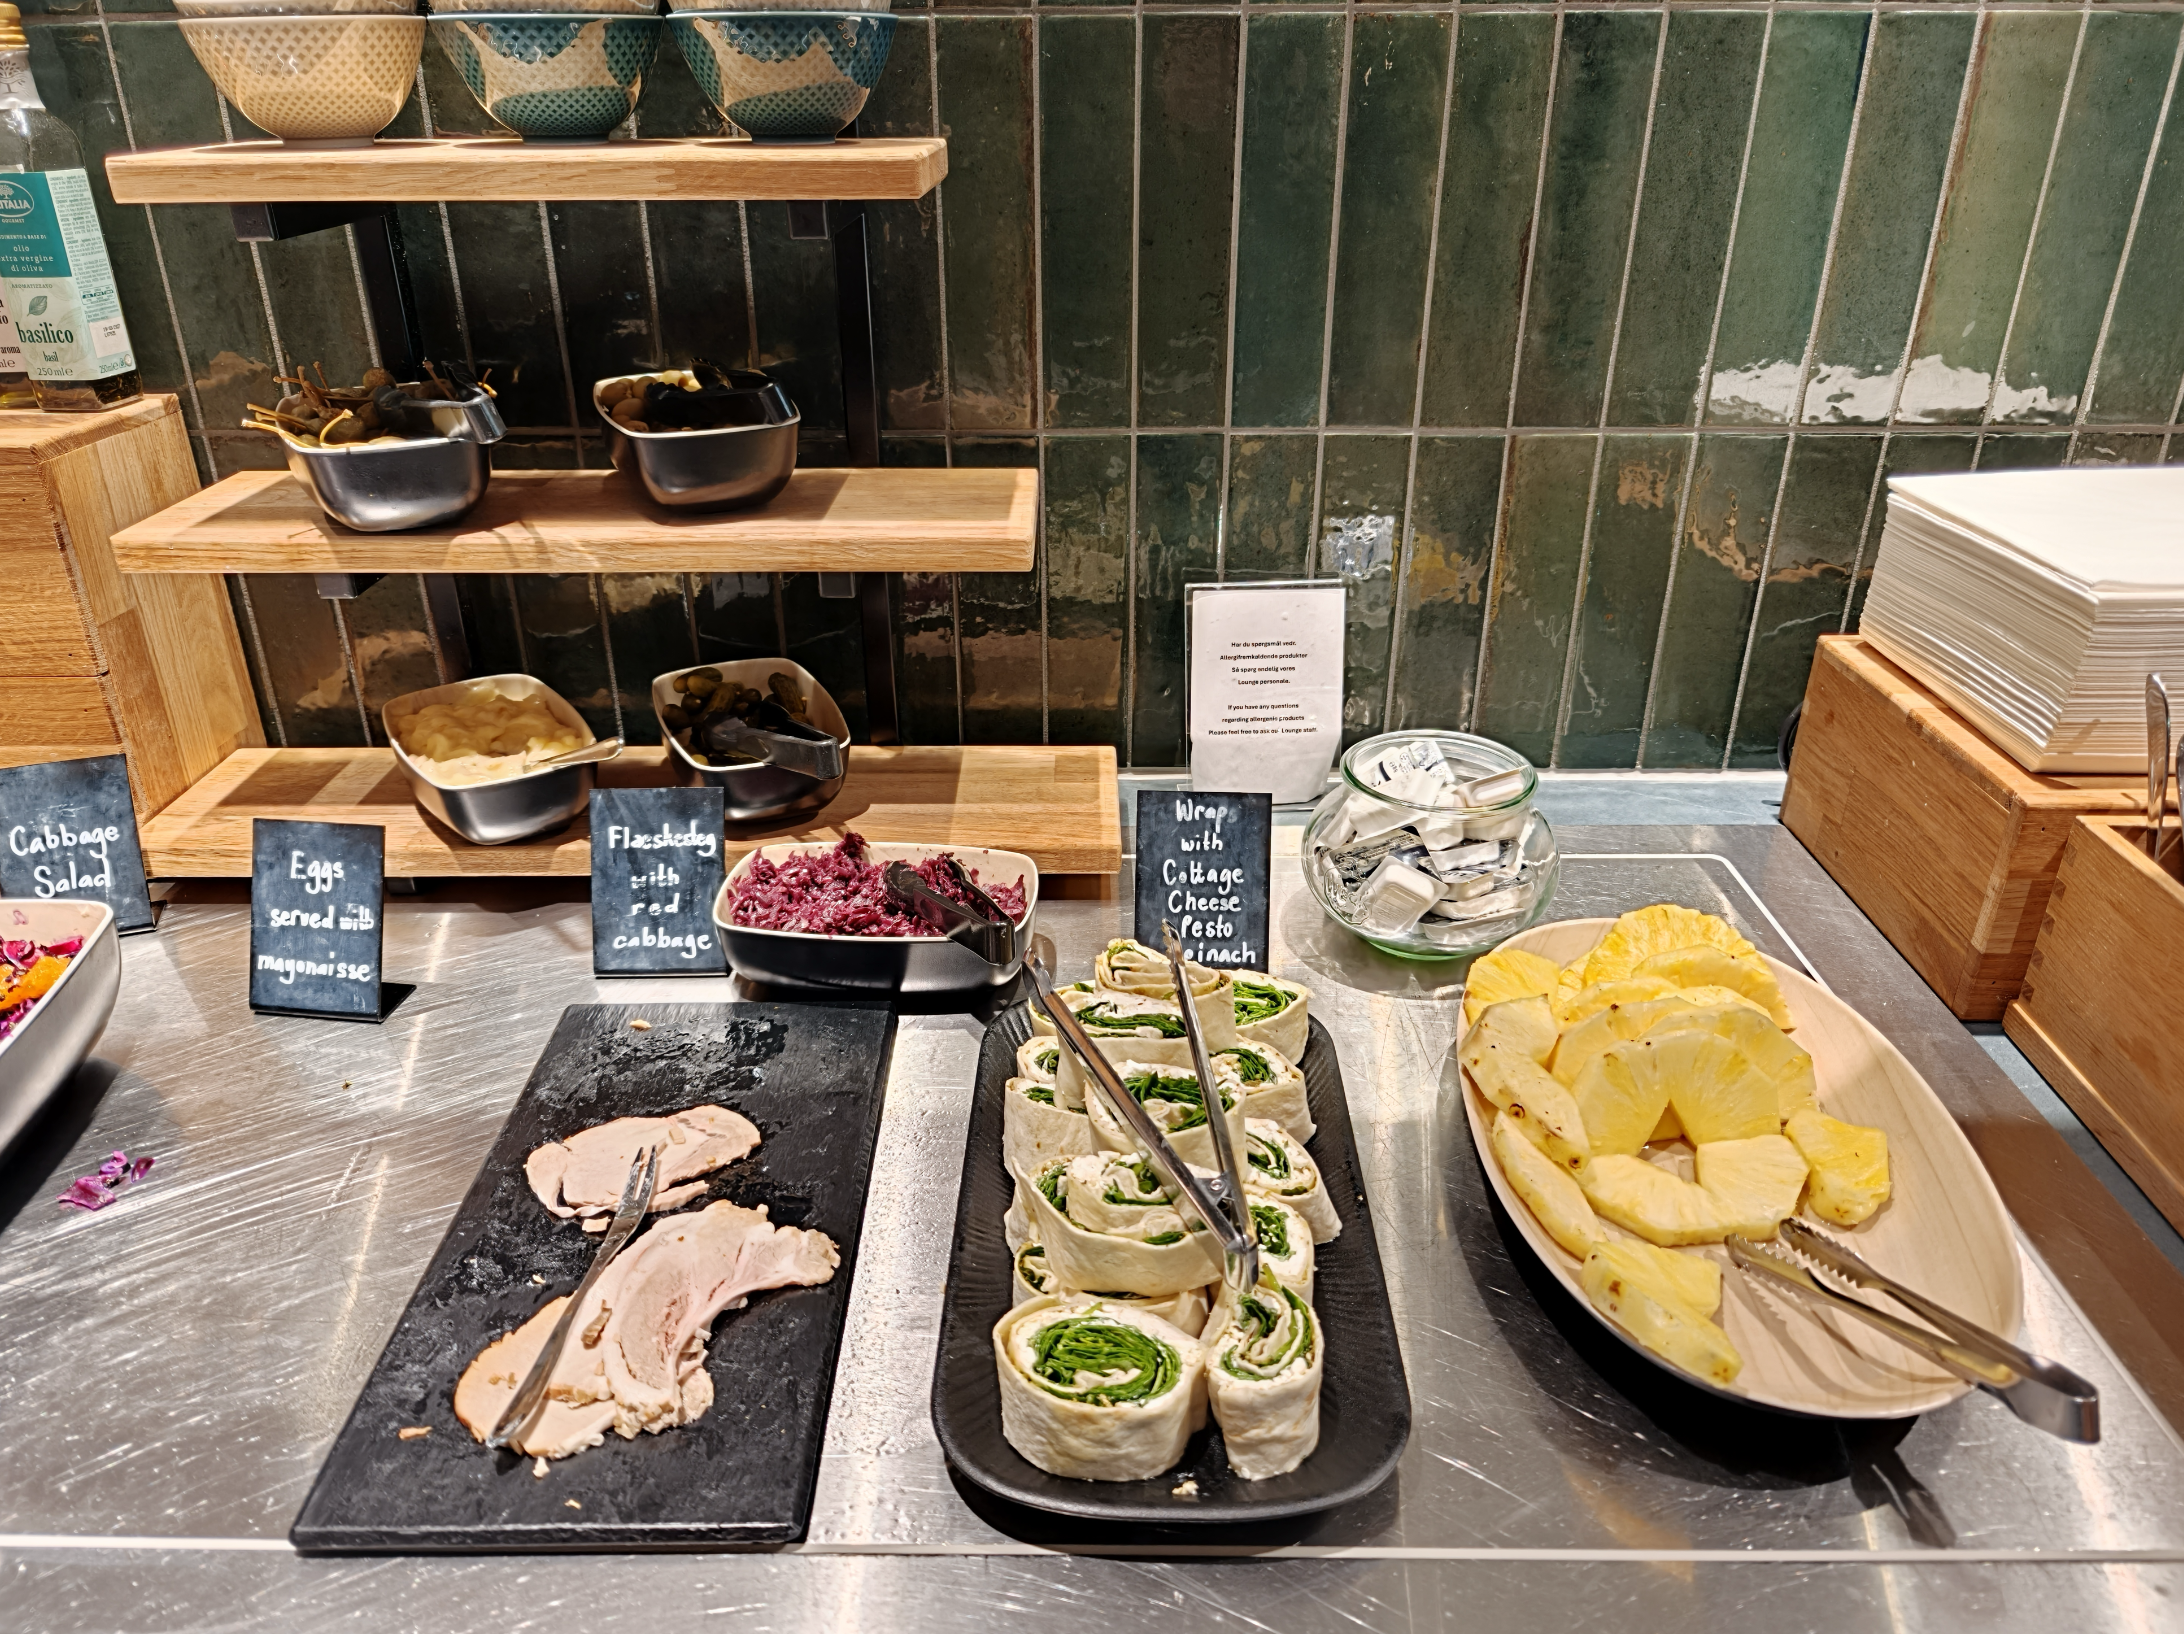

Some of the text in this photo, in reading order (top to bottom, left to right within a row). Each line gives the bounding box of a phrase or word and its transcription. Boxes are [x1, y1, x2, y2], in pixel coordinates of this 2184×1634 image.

[0, 199, 31, 210] ITALIA
[11, 264, 44, 272] di oliva
[20, 255, 54, 264] vergine
[15, 321, 74, 344] basilico
[43, 351, 59, 362] basil
[1279, 652, 1308, 660] produkter
[9, 823, 120, 859] Cabbage
[1181, 830, 1224, 851] with
[33, 858, 112, 899] Salad
[290, 850, 345, 895] Eggs
[630, 863, 680, 889] with
[1162, 858, 1245, 895] Cottage
[631, 892, 680, 916] red
[1167, 889, 1242, 914] Cheese
[270, 904, 375, 931] served with
[1181, 913, 1234, 939] Pesto
[612, 926, 713, 959] cabbage
[257, 951, 372, 985] mayonaisse
